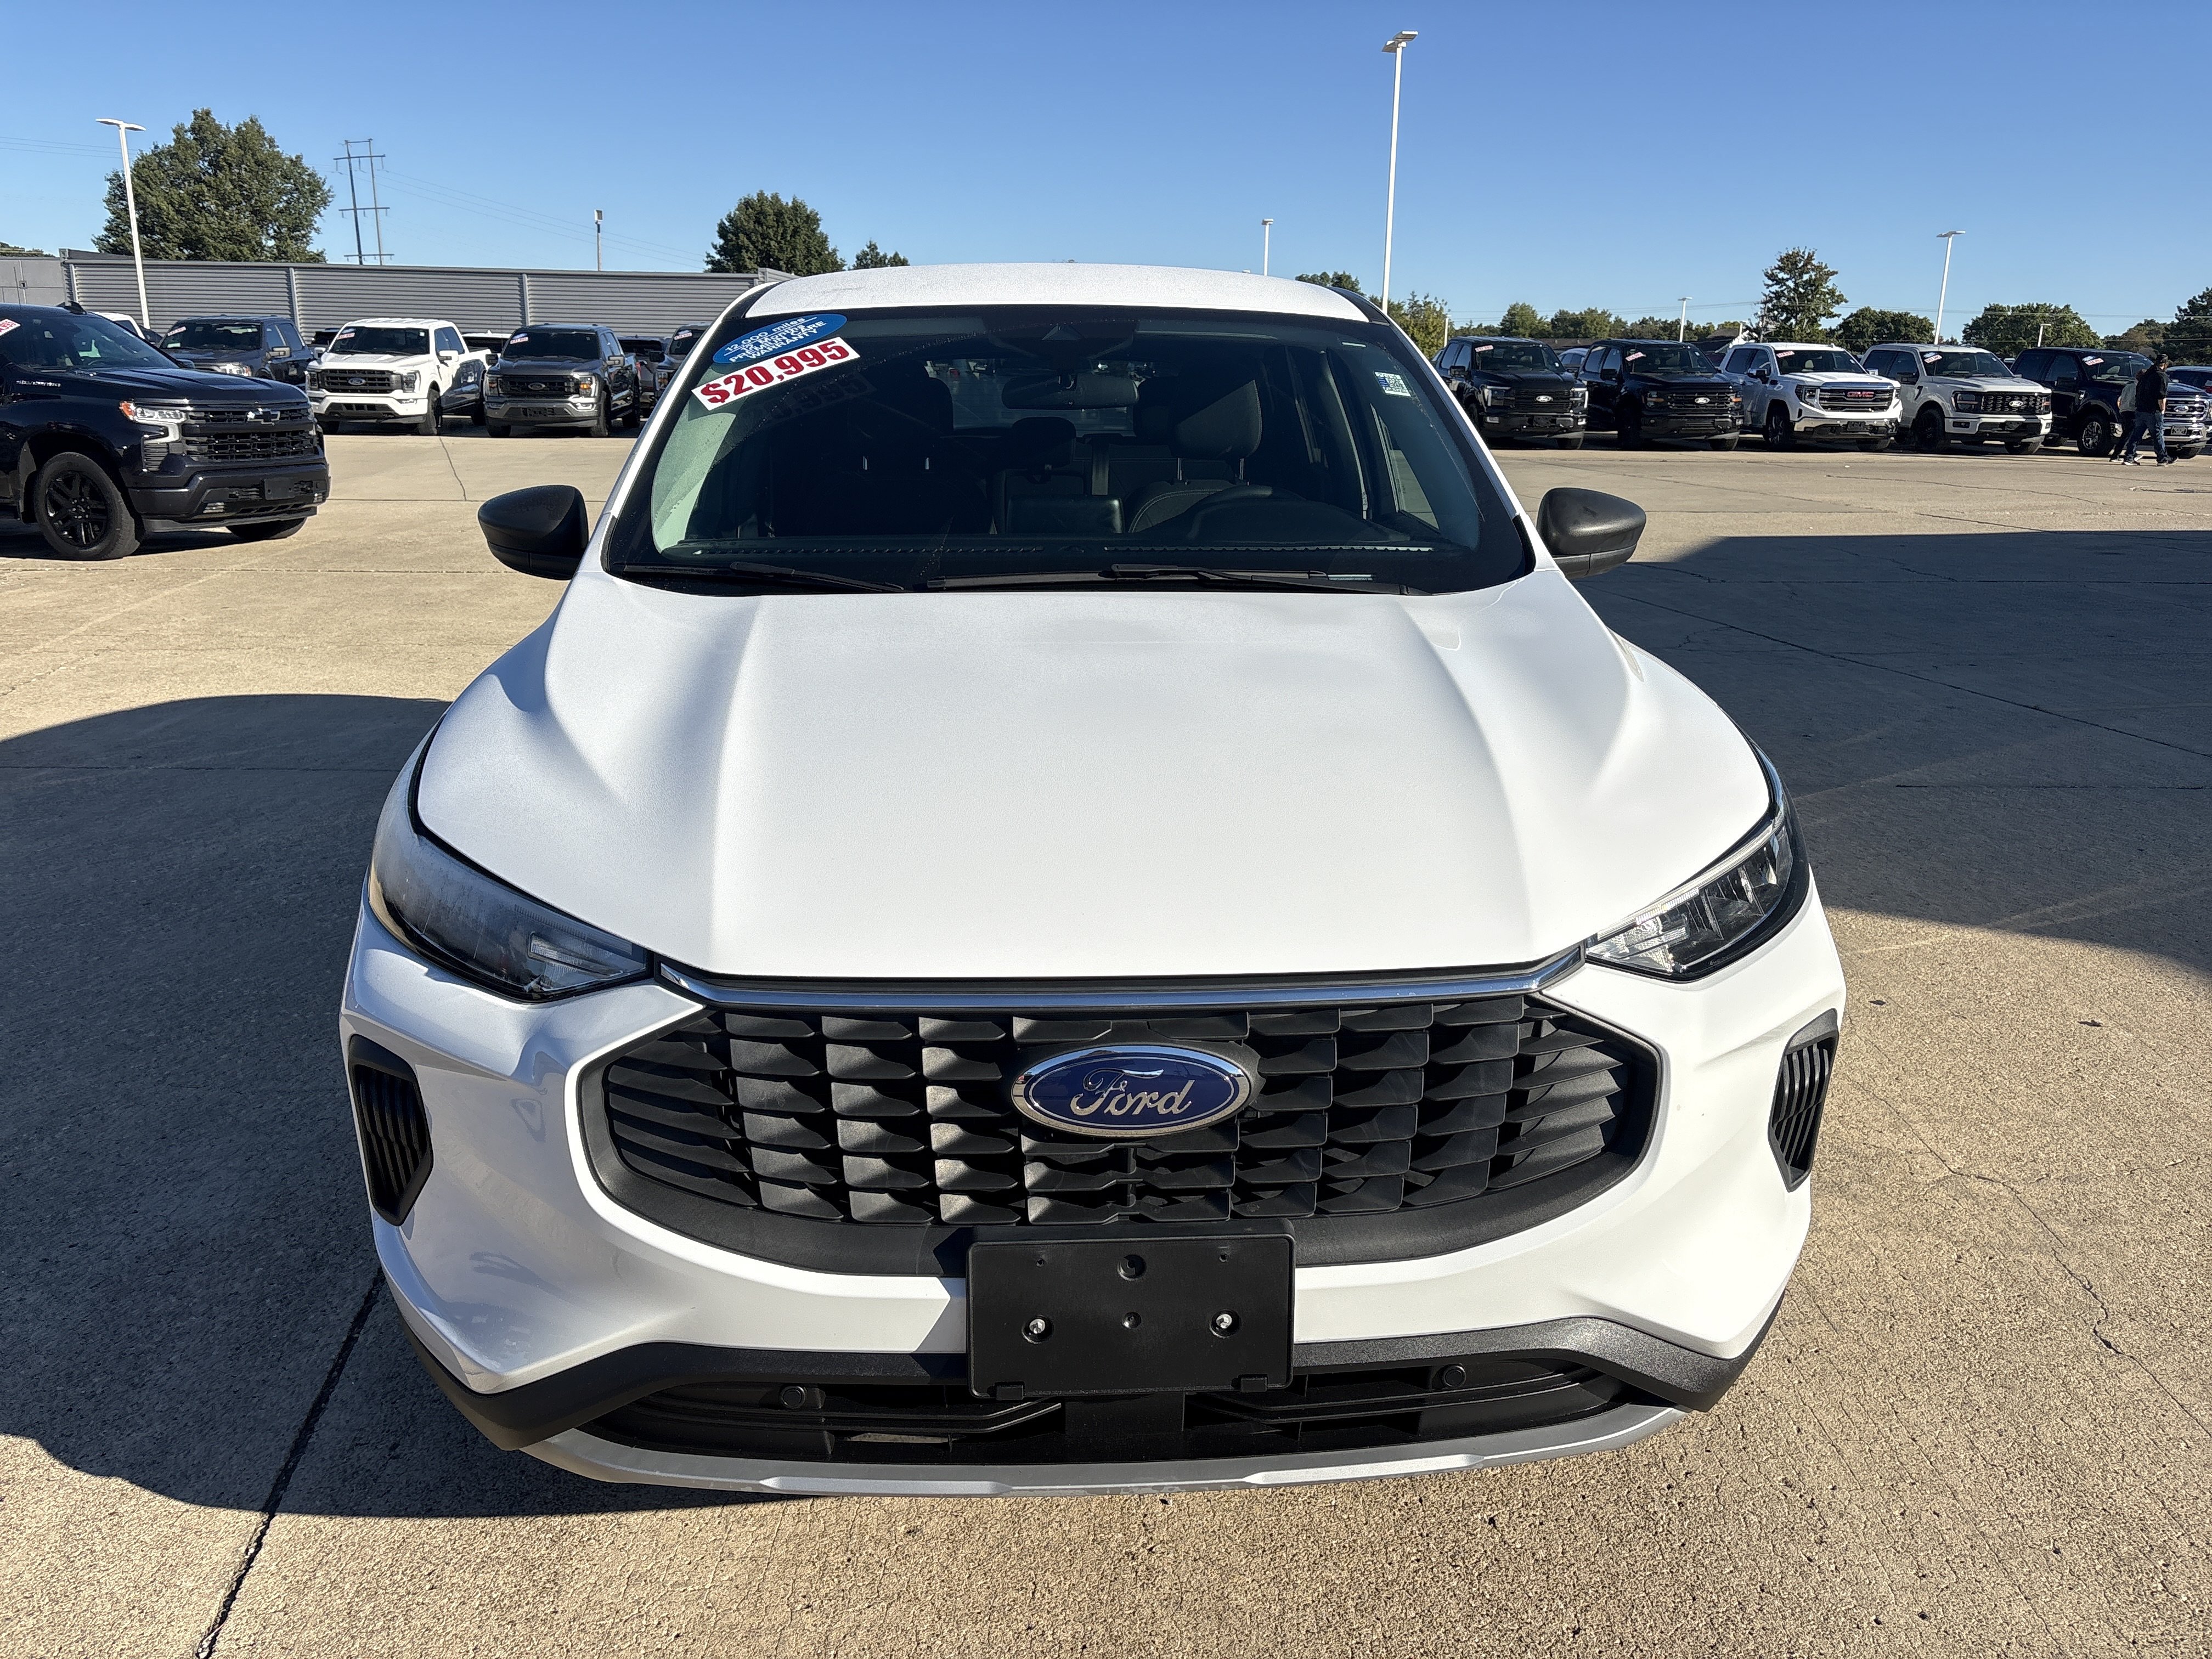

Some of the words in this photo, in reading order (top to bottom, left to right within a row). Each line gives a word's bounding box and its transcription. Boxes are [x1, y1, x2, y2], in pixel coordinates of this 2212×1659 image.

[725, 331, 769, 352] 12,000
[771, 318, 806, 332] miles
[748, 329, 817, 359] WARRANTY
[791, 321, 827, 336] CARE
[701, 341, 850, 403] $20,995
[1070, 1068, 1195, 1116] Ford
